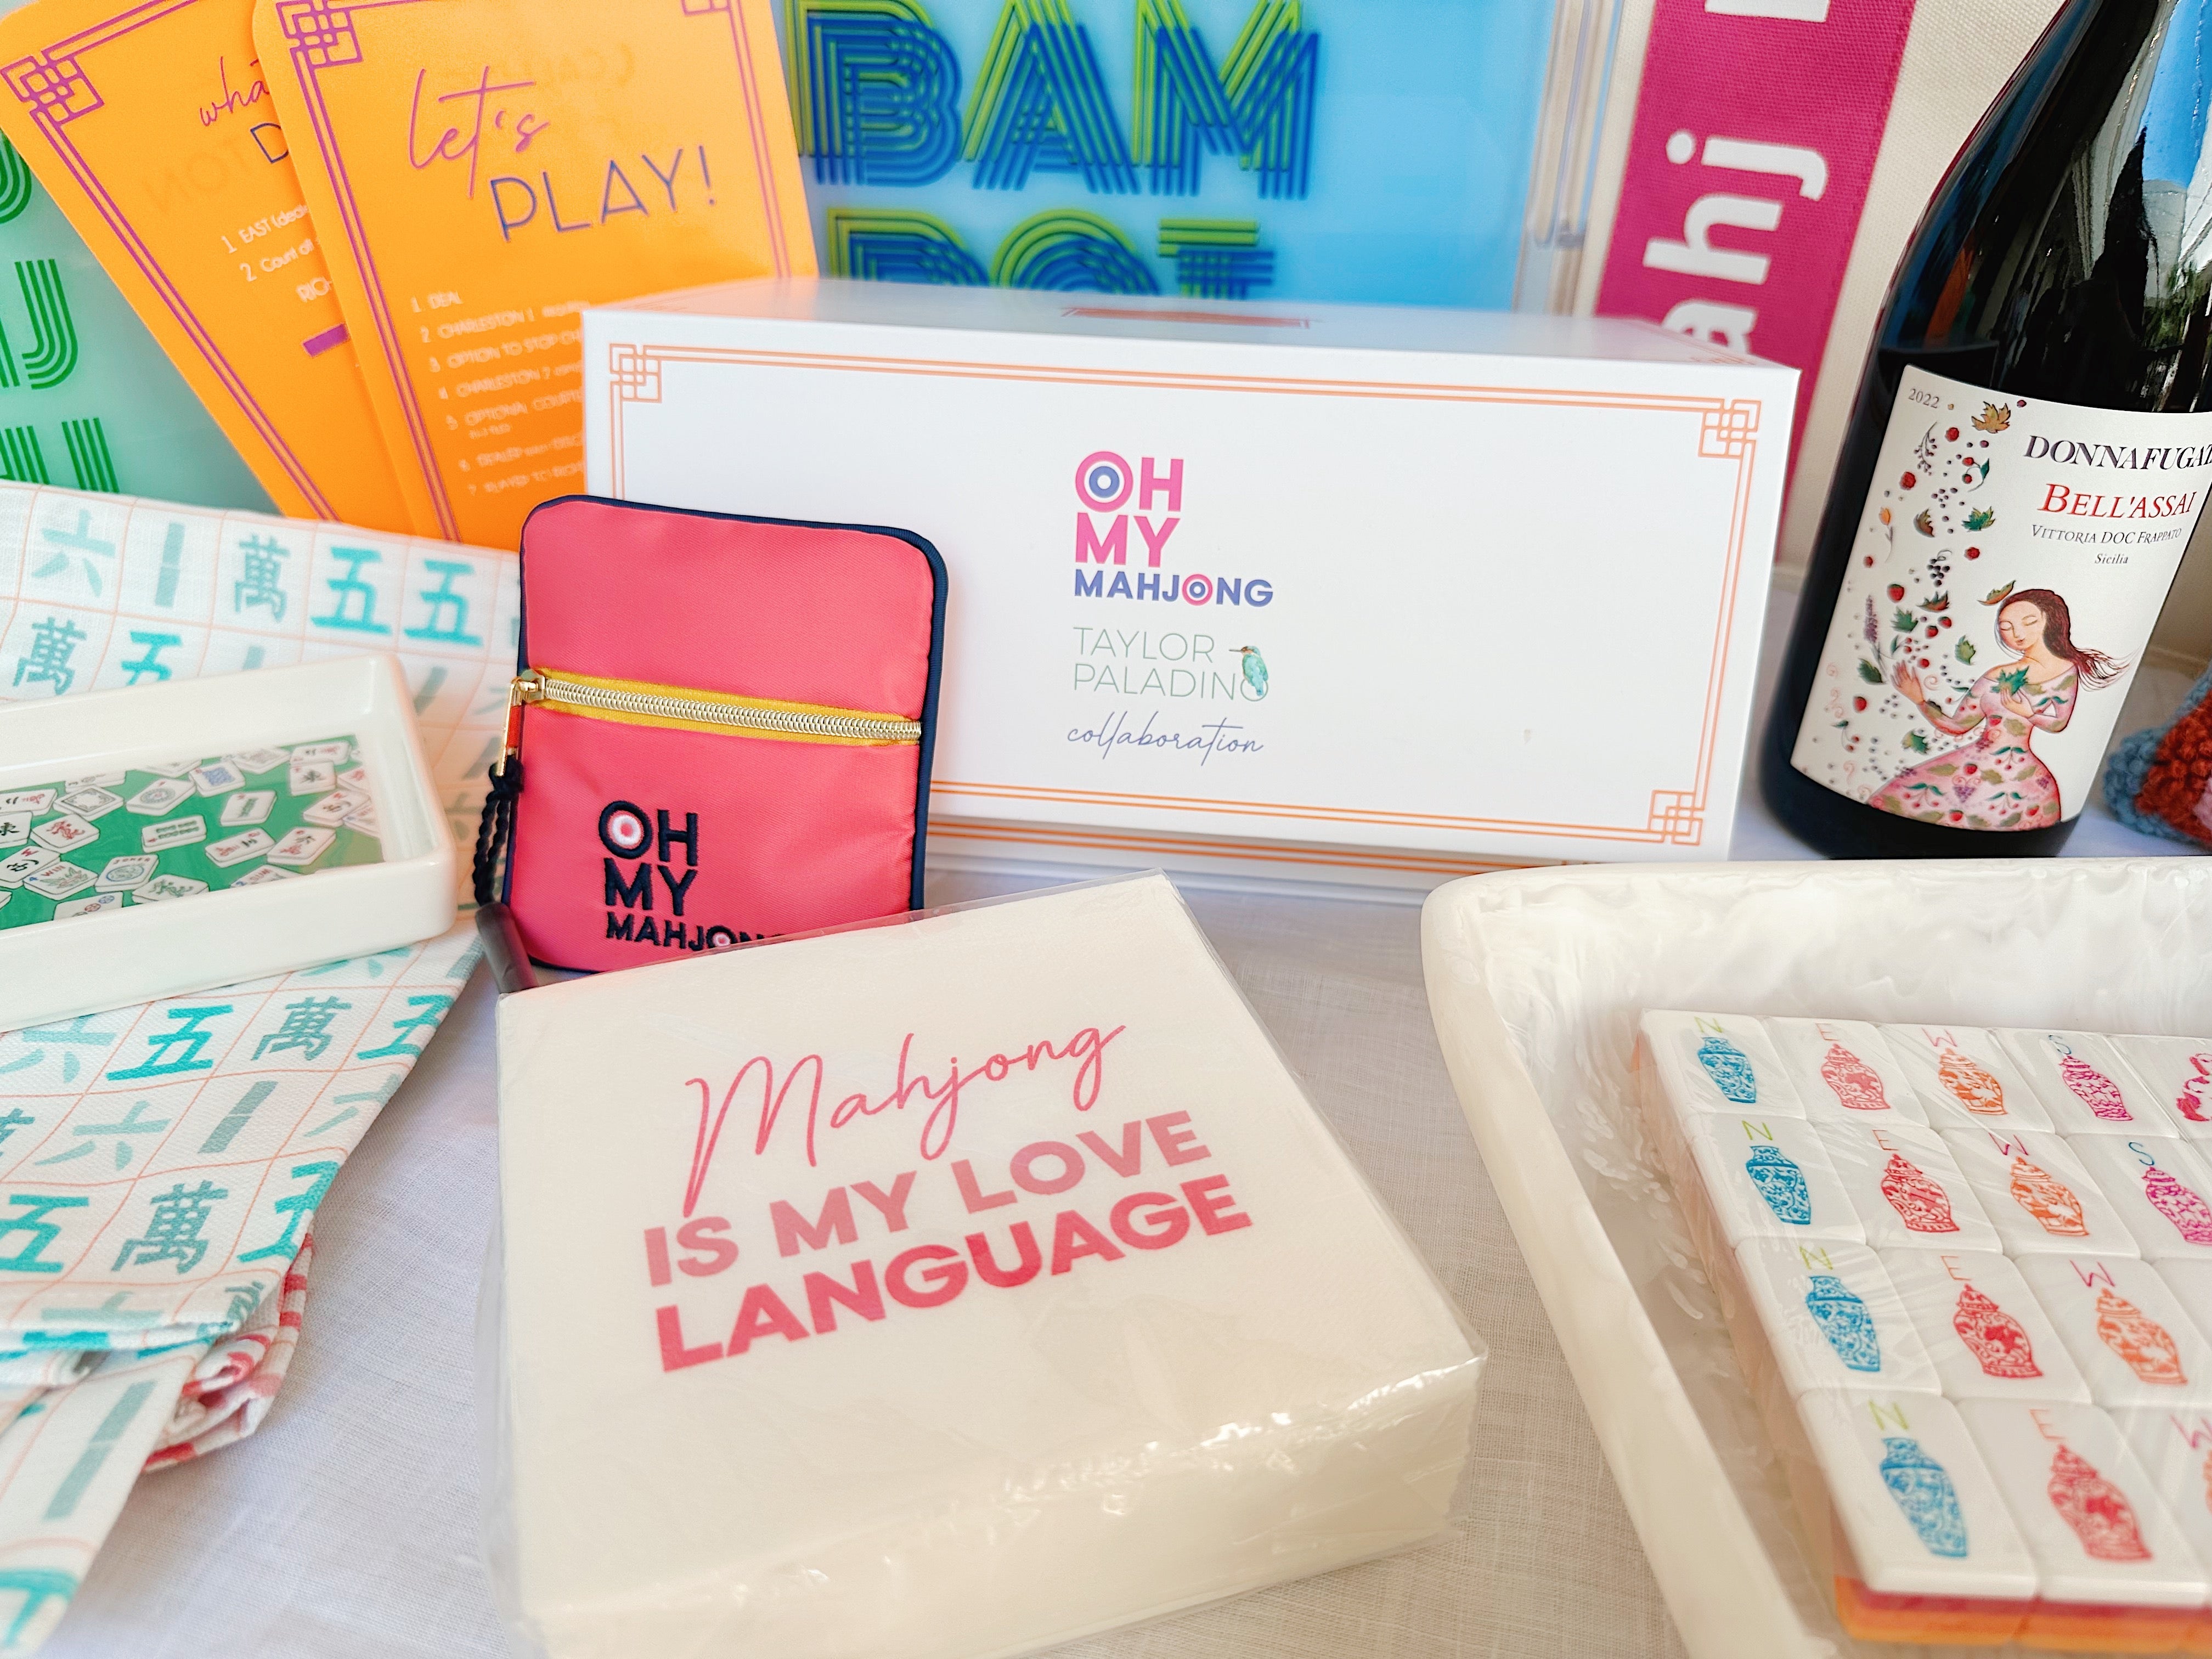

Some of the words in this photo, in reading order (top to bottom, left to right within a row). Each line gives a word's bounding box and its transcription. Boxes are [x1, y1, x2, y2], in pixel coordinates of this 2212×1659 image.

[200, 56, 270, 126] wha
[786, 0, 1318, 199] BAM
[409, 66, 549, 199] let's
[490, 145, 716, 242] PLAY!
[1908, 388, 1940, 409] 2022
[1075, 450, 1184, 513] OH
[1075, 511, 1181, 568] MY
[2100, 532, 2135, 544] DOC
[2095, 553, 2129, 565] Sicilia
[310, 545, 393, 637] 五
[403, 558, 482, 647] 五
[1074, 568, 1273, 607] MAHJONG
[1073, 627, 1214, 663] TAYLOR
[1074, 663, 1268, 702] PALADINO
[1067, 711, 1264, 766] collaboration
[598, 800, 698, 866] OH
[603, 857, 698, 917] MY
[605, 911, 788, 952] MAHJO
[105, 1003, 234, 1081] 五
[1694, 1016, 1724, 1033] N
[1815, 1022, 1839, 1041] E
[1921, 1028, 1957, 1047] W
[684, 1025, 1126, 1218] Mahjong
[1741, 1119, 1773, 1141] N
[1872, 1129, 1899, 1151] E
[1988, 1132, 2029, 1156] W
[2128, 1141, 2155, 1166] S
[644, 1216, 740, 1287] IS
[769, 1171, 917, 1257] MY
[950, 1110, 1212, 1214] LOVE
[656, 1173, 1253, 1373] LANGUAGE
[1798, 1246, 1833, 1271] N
[1940, 1255, 1972, 1281] E
[2069, 1259, 2116, 1288] W
[1867, 1400, 1910, 1431] N
[2029, 1408, 2065, 1440] E
